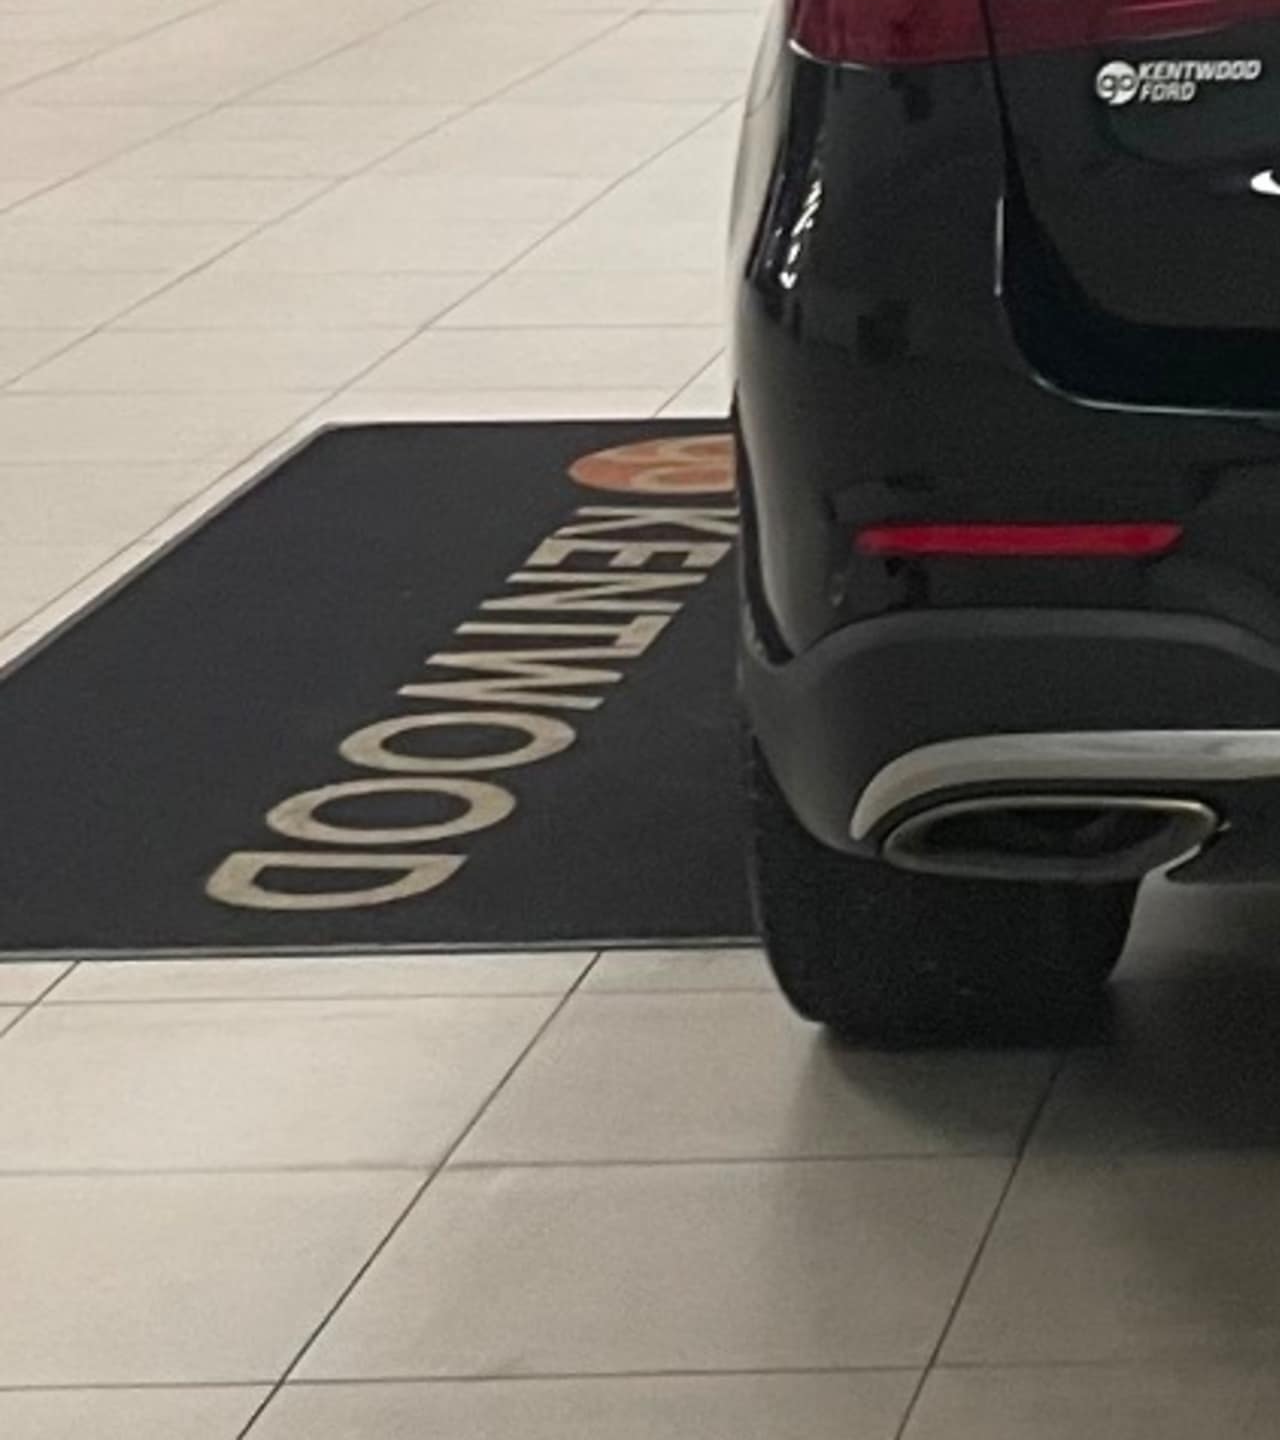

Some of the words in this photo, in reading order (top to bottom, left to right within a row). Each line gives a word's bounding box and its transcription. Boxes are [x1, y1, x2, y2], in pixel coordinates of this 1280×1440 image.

[1138, 59, 1263, 81] KENTWOOD
[1138, 81, 1198, 103] FORD
[205, 506, 739, 911] KENTWOOD
